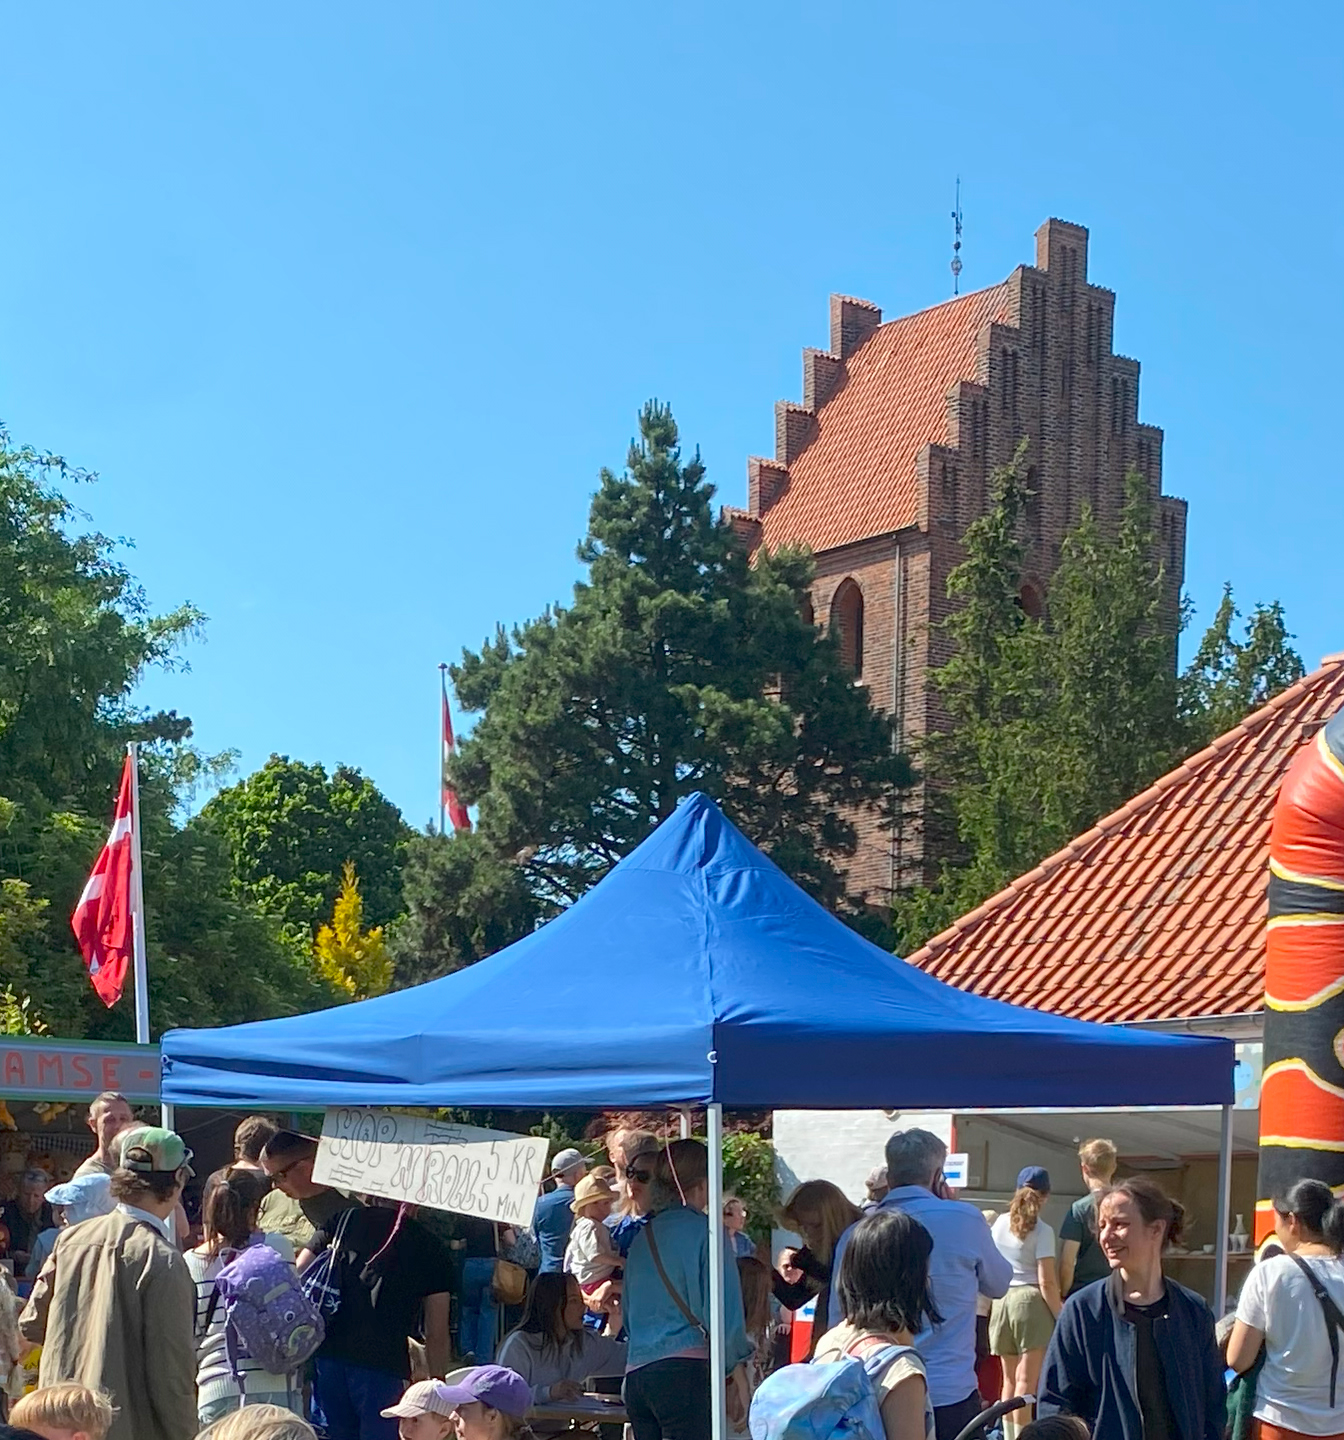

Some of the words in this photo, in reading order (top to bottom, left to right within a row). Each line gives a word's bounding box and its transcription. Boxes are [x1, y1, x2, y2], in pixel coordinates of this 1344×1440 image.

[415, 1150, 482, 1212] ROLL
[487, 1139, 500, 1181] 5
[509, 1143, 538, 1185] KR
[478, 1182, 493, 1213] 5
[496, 1192, 525, 1220] MIN
